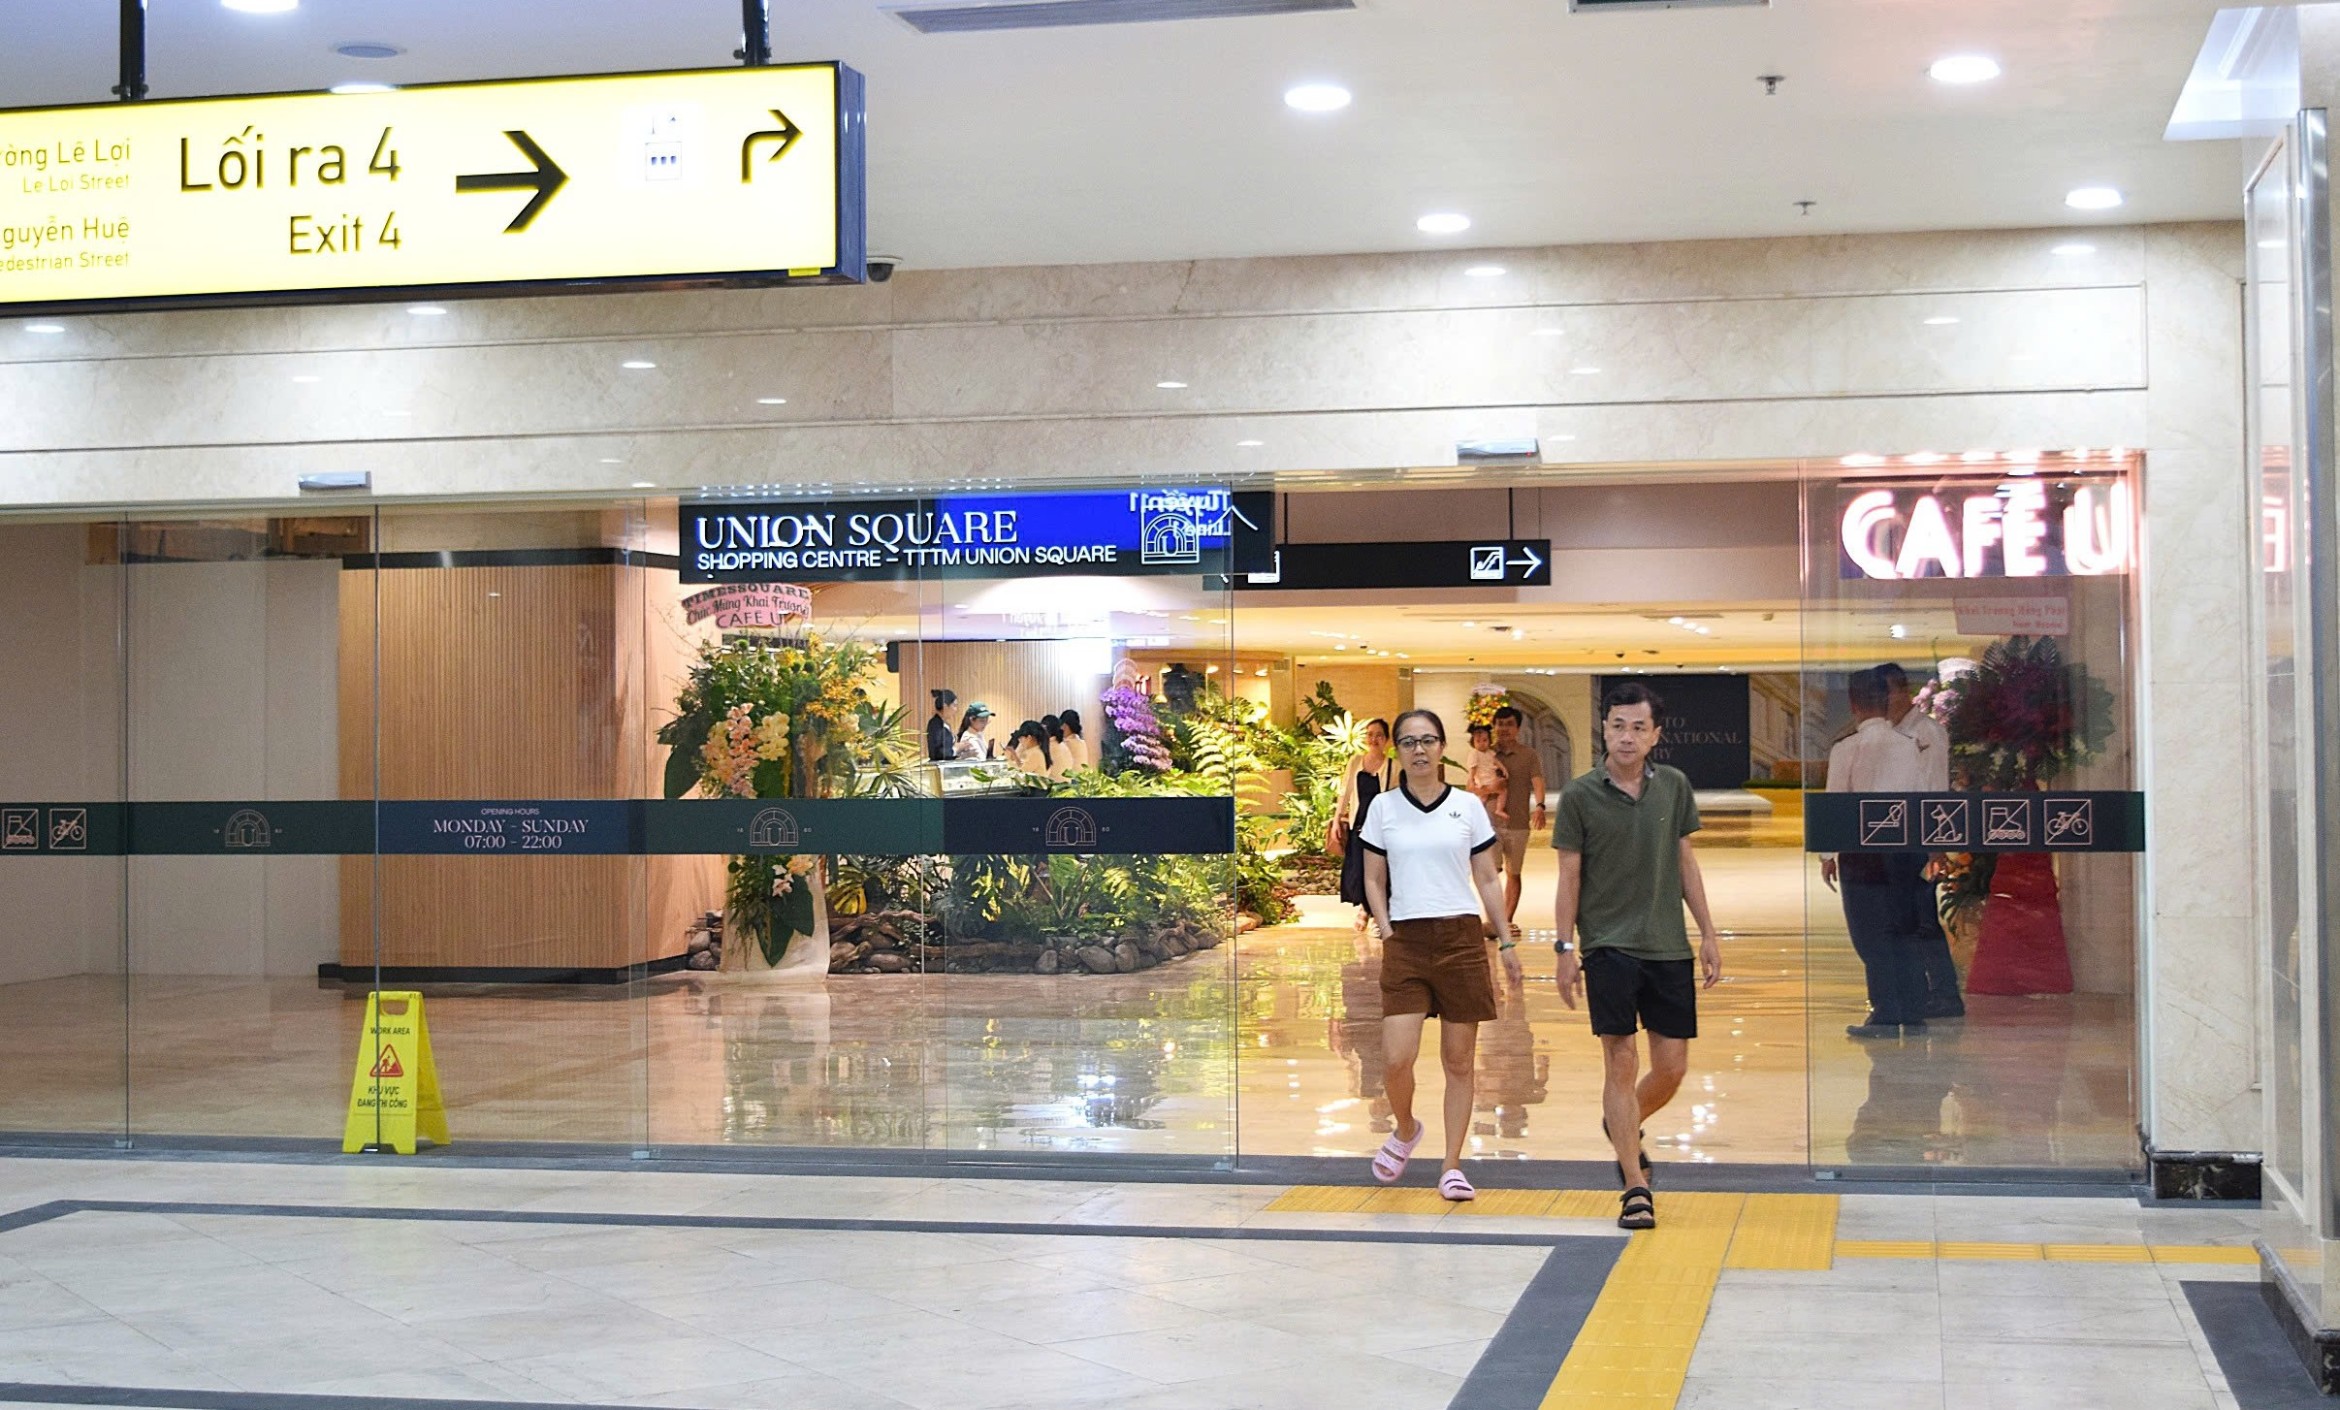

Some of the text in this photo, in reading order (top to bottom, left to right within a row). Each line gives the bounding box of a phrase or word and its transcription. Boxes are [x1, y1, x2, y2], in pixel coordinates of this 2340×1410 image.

[58, 140, 85, 164] Lê
[180, 125, 402, 193] Lối ra 4
[23, 172, 130, 193] Le Loi Street
[83, 217, 130, 245] Huệ
[290, 211, 402, 255] Exit 4
[0, 250, 130, 272] edestrian Street
[697, 509, 1018, 553] UNION SQUARE
[697, 552, 799, 571] SHOPPING
[801, 549, 882, 569] CENTRE
[903, 548, 961, 567] TTTM
[965, 546, 1031, 565] UNION
[1034, 545, 1118, 565] SQUARE
[481, 808, 540, 816] OPENING HOURS
[433, 819, 506, 833] MONDAY
[521, 819, 589, 833] SUNDAY
[464, 835, 506, 849] 07:00
[521, 835, 562, 849] 22:00
[393, 1027, 410, 1035] AREA
